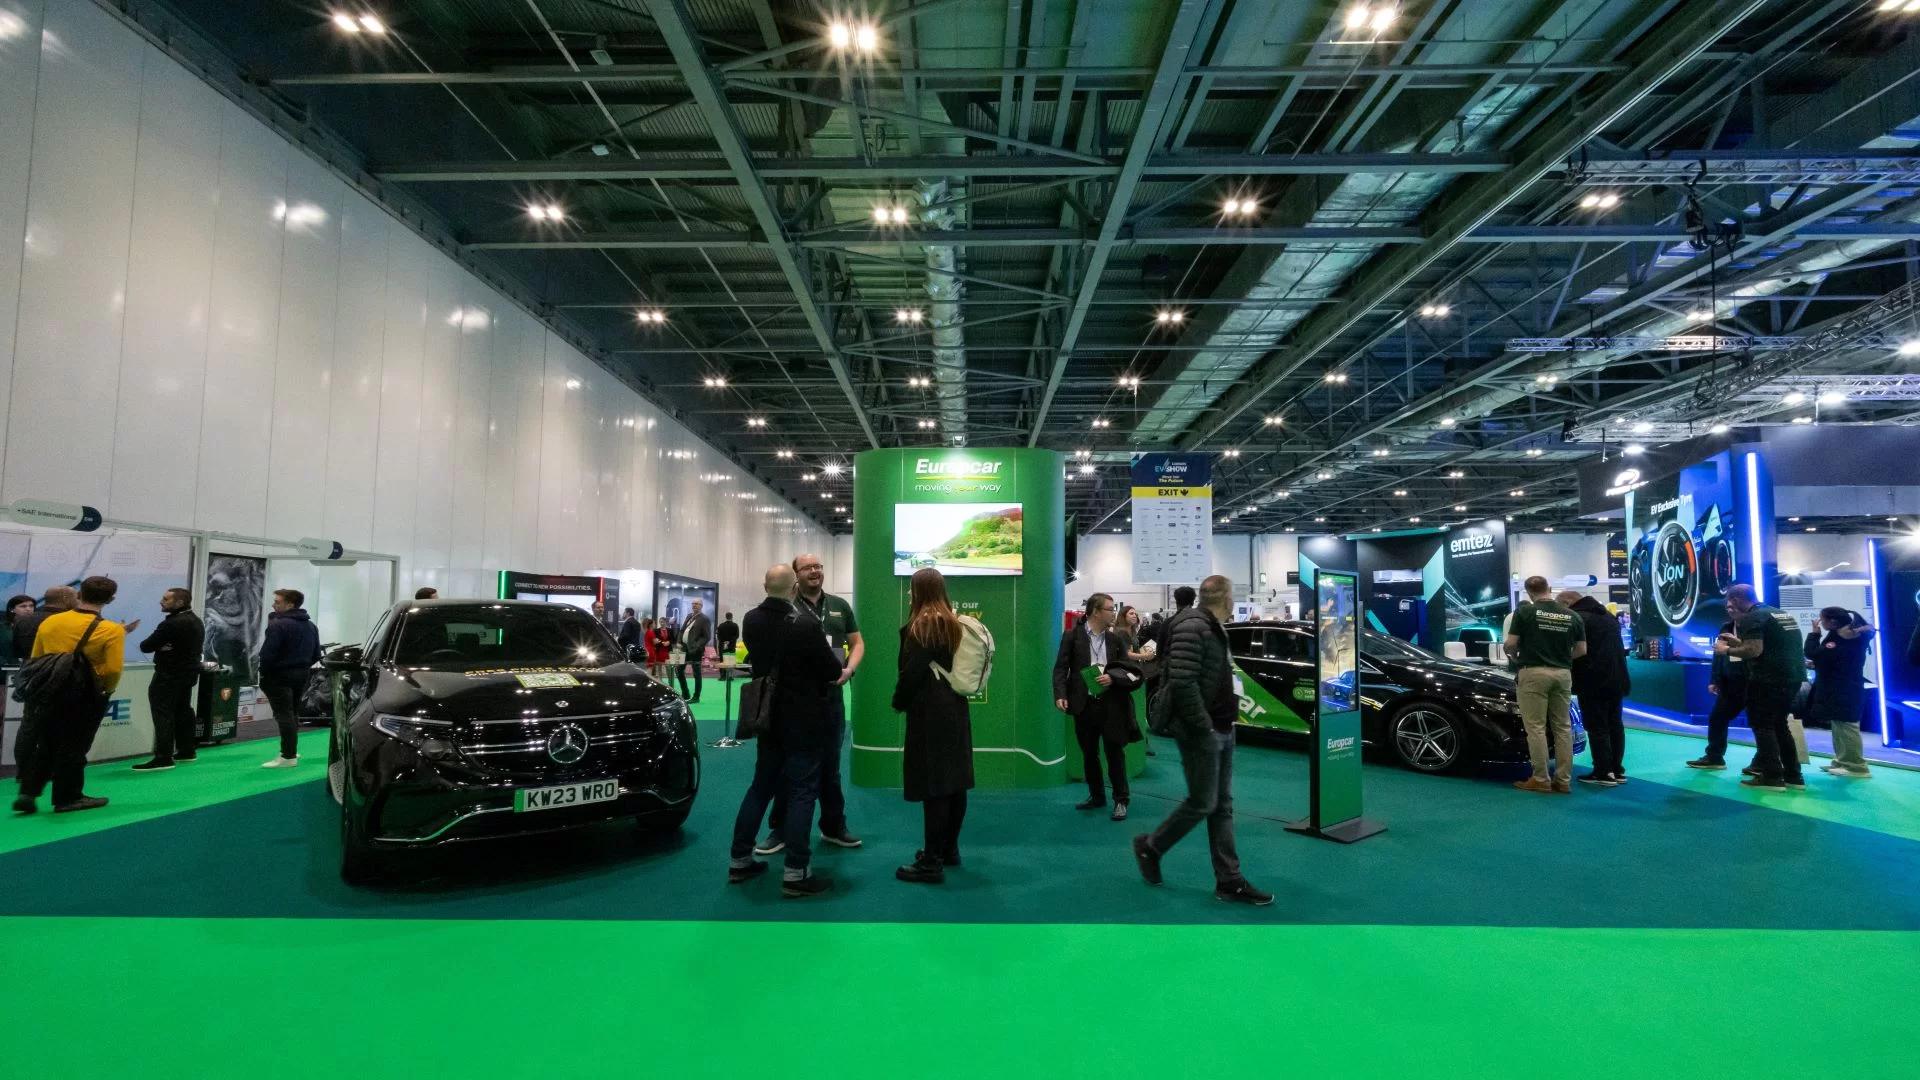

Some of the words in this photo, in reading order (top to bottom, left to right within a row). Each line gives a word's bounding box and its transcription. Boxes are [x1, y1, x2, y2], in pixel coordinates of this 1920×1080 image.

[915, 459, 1002, 475] Eurpcar
[914, 484, 952, 494] moving
[979, 484, 1001, 494] way
[1650, 505, 1658, 515] EV
[1658, 498, 1680, 513] Exclusive
[38, 511, 78, 520] International
[1536, 609, 1571, 619] Europcar
[1327, 737, 1355, 750] Europcar
[527, 787, 577, 808] KW23
